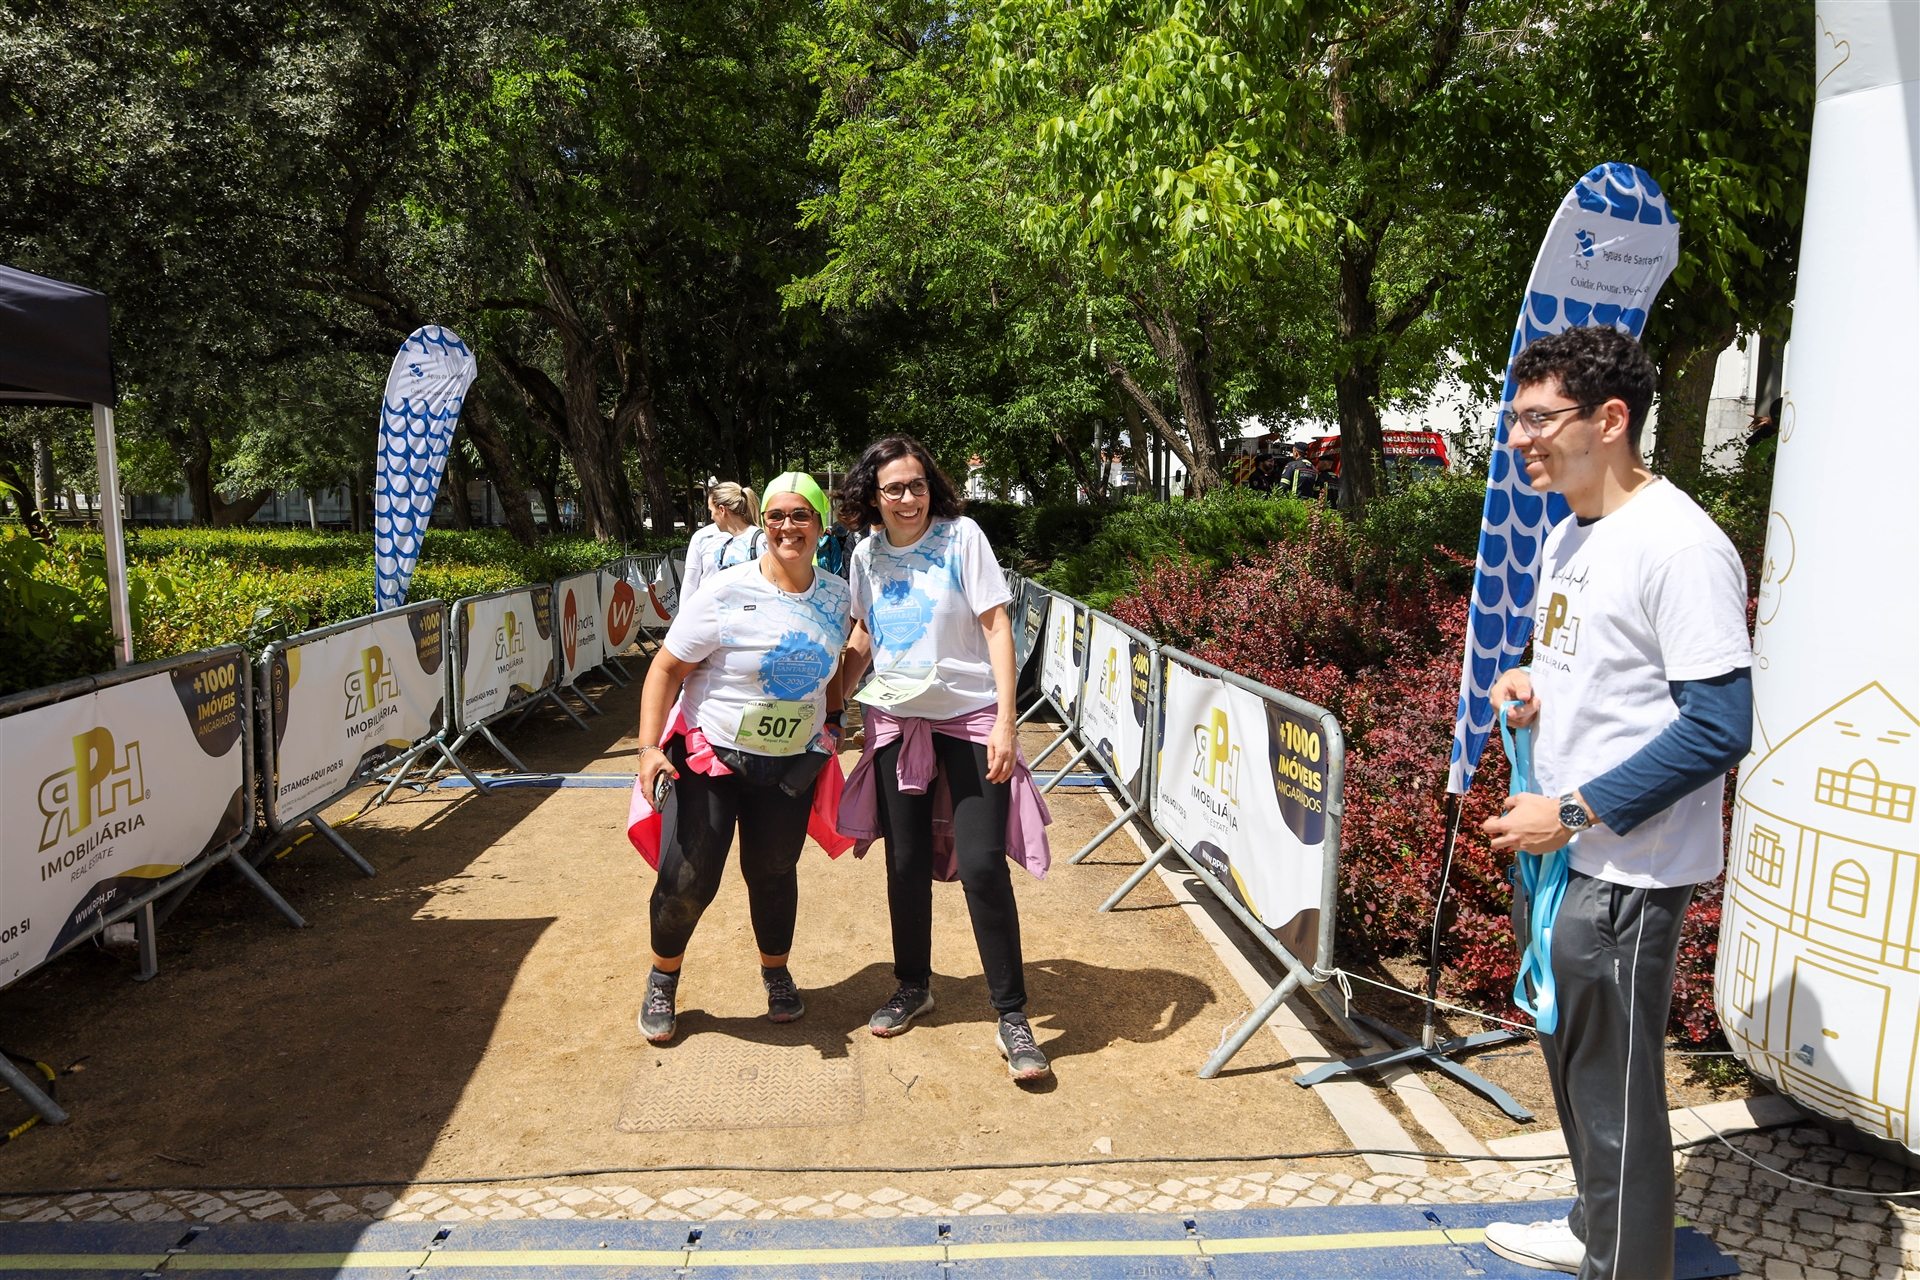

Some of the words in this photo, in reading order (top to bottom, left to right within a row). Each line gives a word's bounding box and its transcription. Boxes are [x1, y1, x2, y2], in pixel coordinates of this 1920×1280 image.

[1624, 253, 1632, 264] de
[1383, 446, 1437, 455] ERGÊNCIA
[419, 611, 440, 631] +1000
[612, 600, 634, 628] W
[193, 663, 236, 694] +1000
[776, 665, 817, 673] SANTARÉM
[197, 691, 236, 721] IMÓVEIS
[198, 711, 236, 737] ANGARIADOS
[346, 704, 398, 739] IMOBILIÁRIA
[757, 715, 802, 738] 507
[1279, 721, 1320, 762] +1000
[280, 775, 310, 796] ESTAMOS
[310, 768, 326, 781] AQUI
[326, 762, 338, 775] POR
[338, 759, 344, 768] SI
[1278, 755, 1322, 793] IMÓVEIS
[1191, 784, 1238, 832] IMOBILIÁIA
[1209, 818, 1229, 835] ESTATE
[41, 814, 145, 882] IMOBILIÁRIA
[70, 864, 88, 883] REAL
[88, 846, 115, 870] ESTATE
[0, 926, 18, 944] OR
[20, 918, 31, 934] SI
